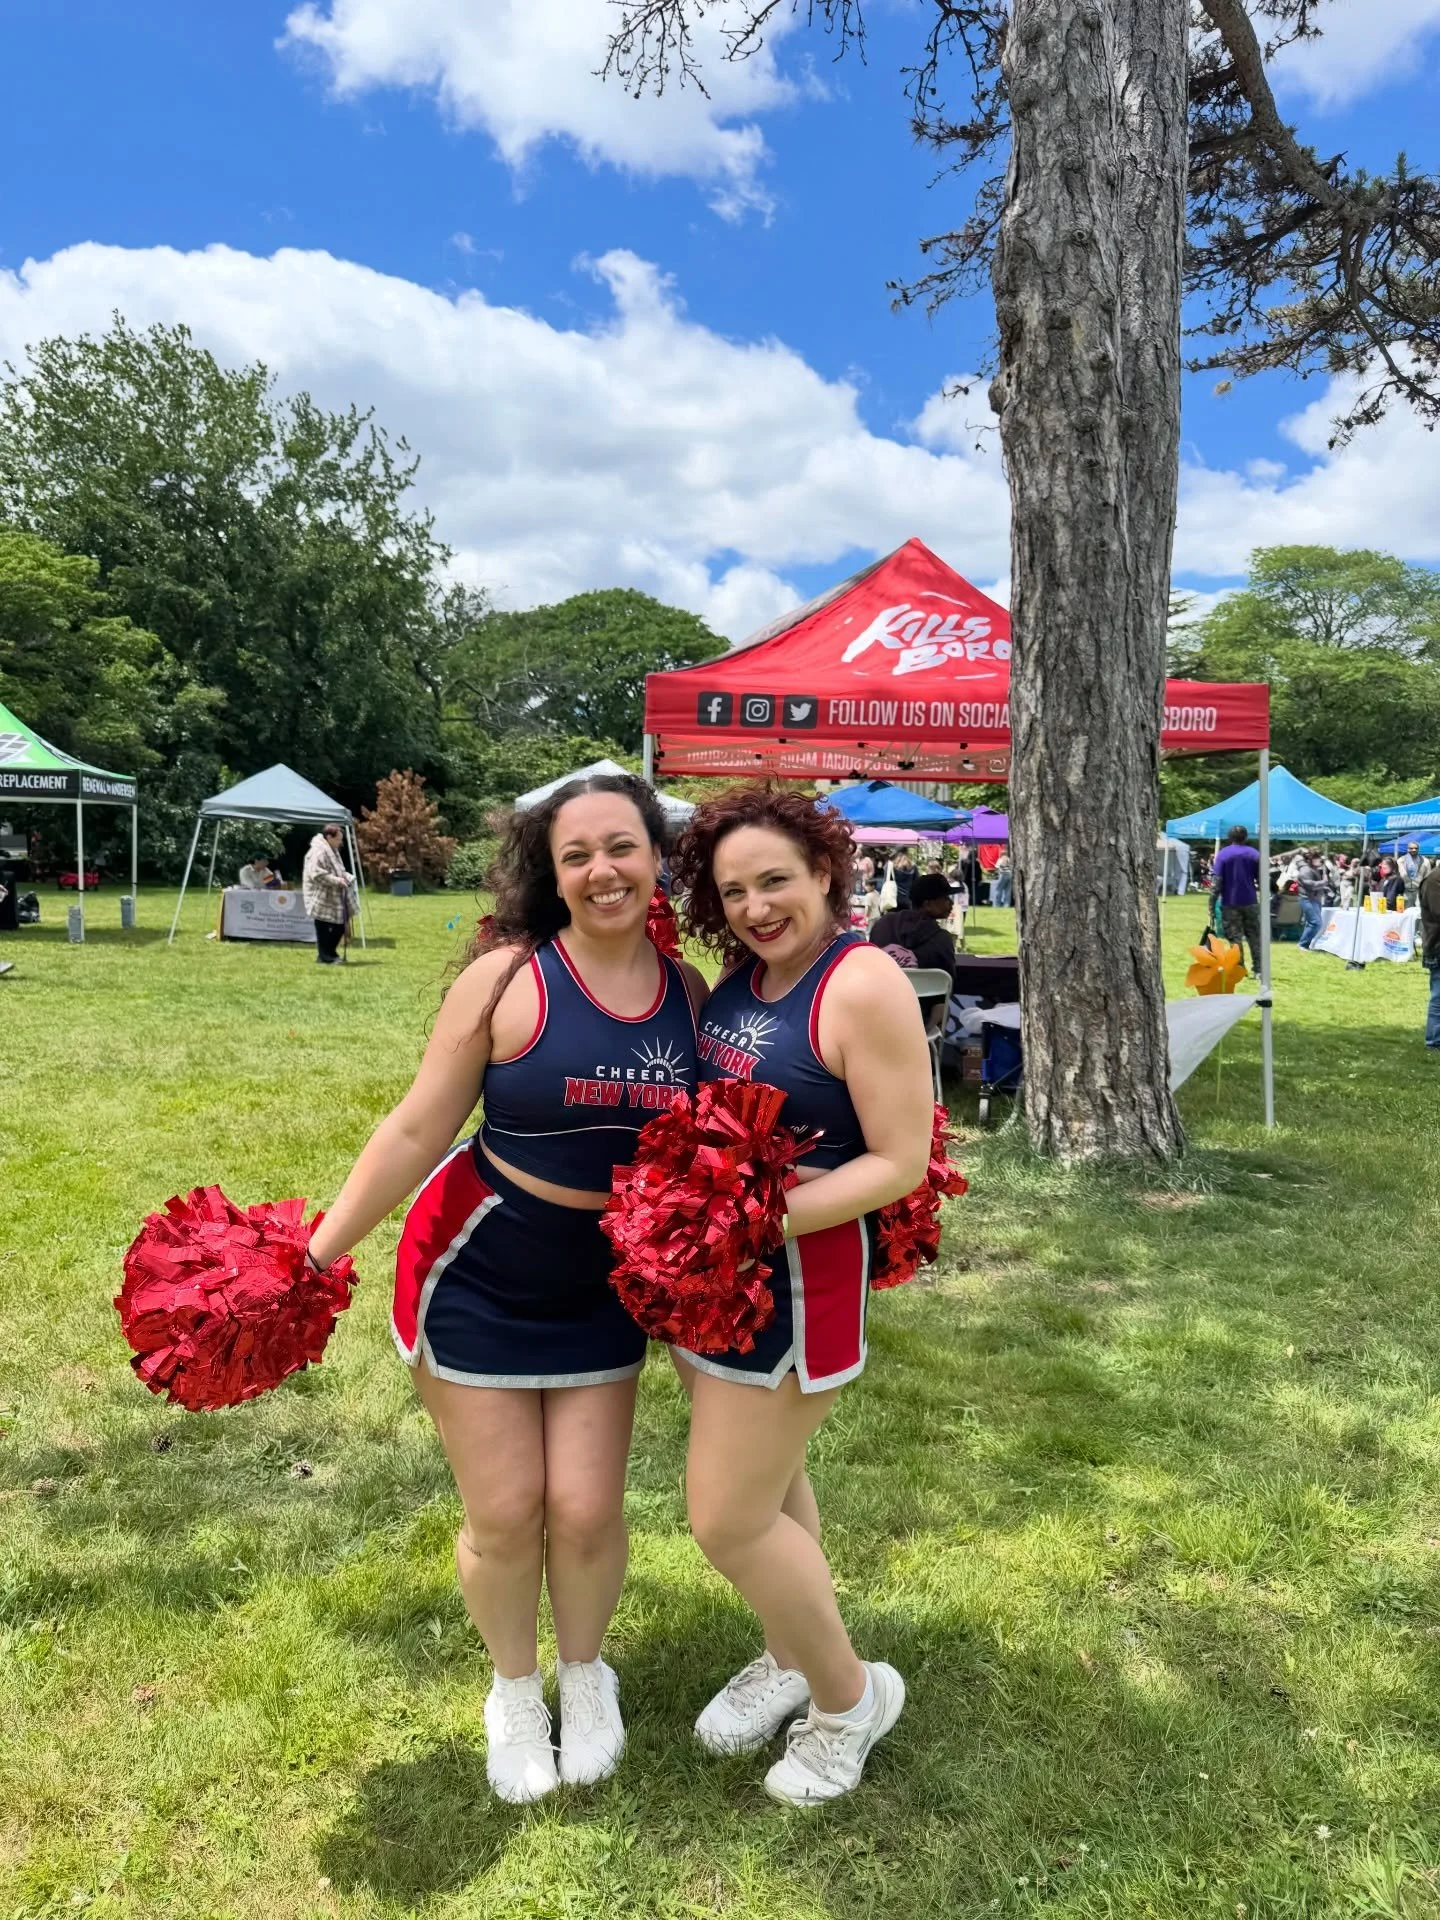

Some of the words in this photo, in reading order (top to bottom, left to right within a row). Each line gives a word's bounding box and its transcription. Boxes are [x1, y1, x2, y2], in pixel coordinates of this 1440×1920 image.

[841, 603, 992, 663] KILLS
[829, 700, 898, 726] FOLLOW
[902, 701, 926, 727] US
[929, 702, 955, 728] ON
[958, 702, 1011, 729] SOCIA
[704, 1021, 748, 1048] CHEER
[595, 1065, 665, 1082] CHEER
[712, 1040, 760, 1080] YORK
[563, 1076, 625, 1107] NEW
